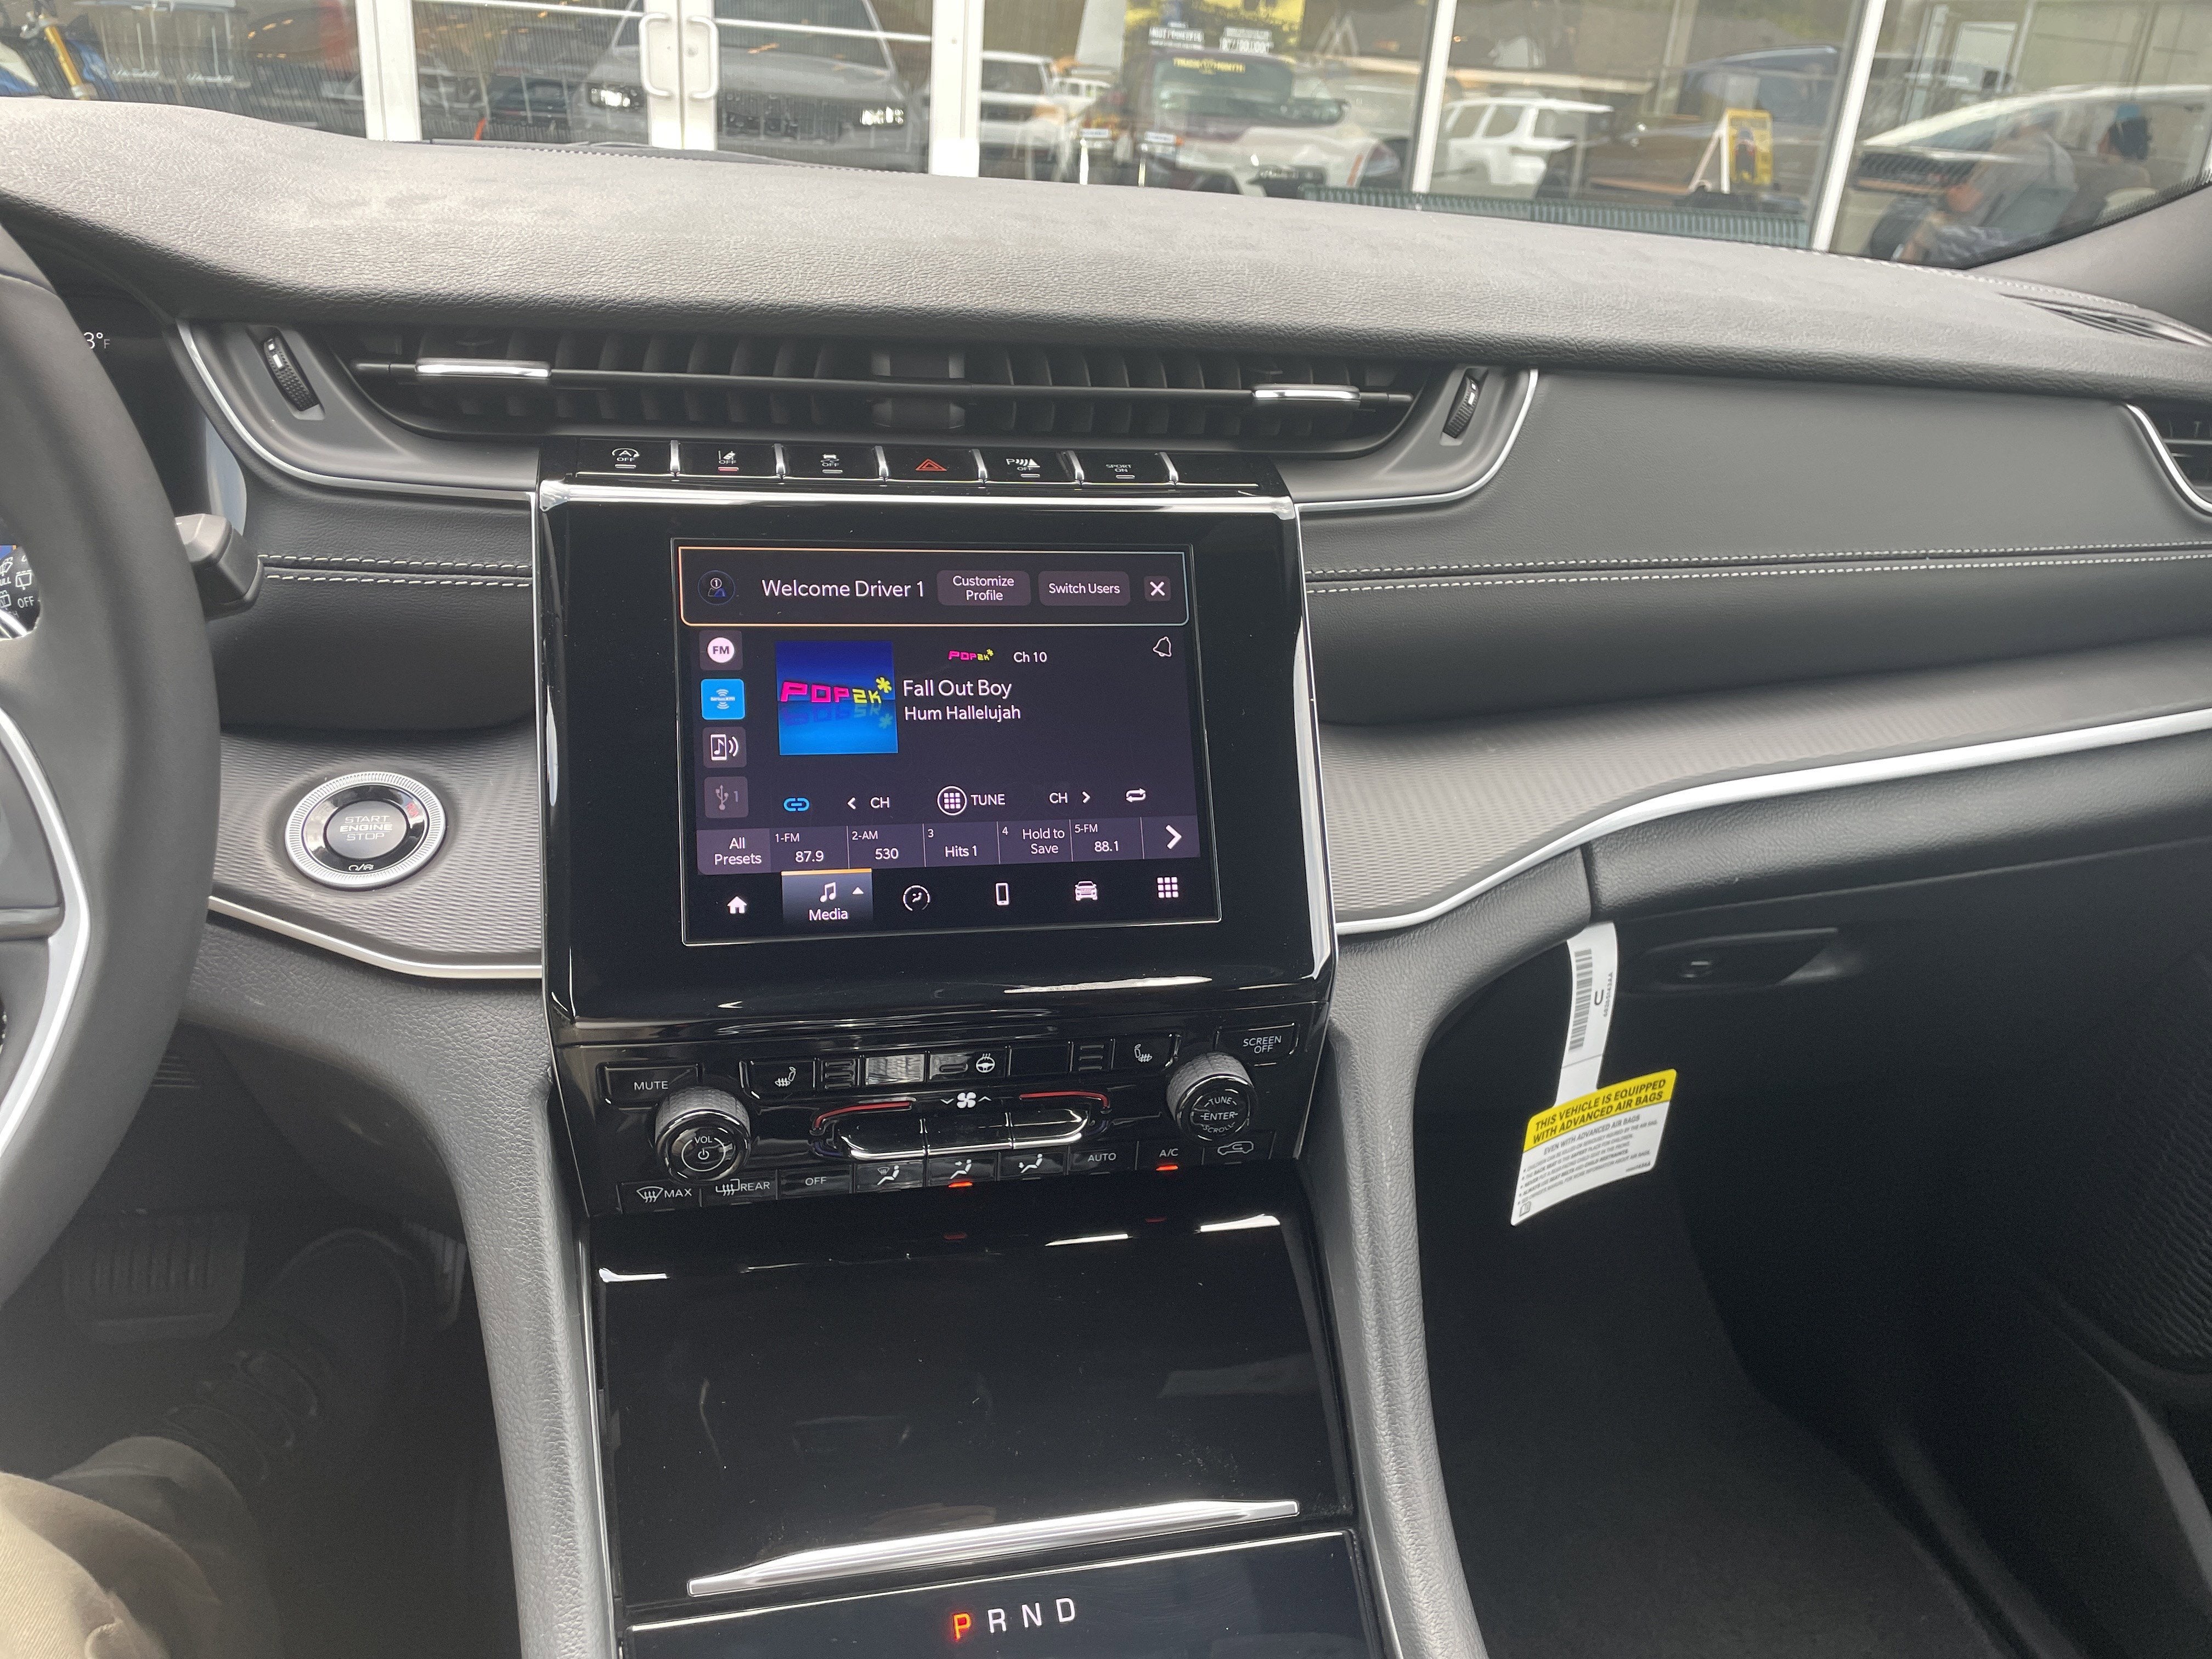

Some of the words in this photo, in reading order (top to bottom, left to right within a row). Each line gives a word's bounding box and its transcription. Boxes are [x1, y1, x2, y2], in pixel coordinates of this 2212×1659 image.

[953, 575, 1014, 586] Customize
[762, 579, 850, 596] Welcome
[855, 580, 911, 597] Driver
[916, 581, 924, 597] 1
[1048, 583, 1086, 594] Switch
[1088, 584, 1120, 594] Users
[966, 590, 1003, 601] Profile
[18, 596, 34, 608] OFF
[713, 646, 730, 654] FM
[1014, 652, 1030, 663] Ch
[1034, 652, 1047, 663] 10
[903, 680, 934, 697] Fall
[938, 680, 974, 696] Out
[978, 679, 1012, 699] Boy
[905, 707, 942, 721] Hum
[946, 704, 1021, 722] Hallelujah
[870, 797, 889, 809] CH
[970, 794, 1006, 805] TUNE
[1049, 792, 1068, 804] CH
[340, 824, 393, 832] ENGINE
[928, 829, 934, 838] 3
[1002, 827, 1008, 836] 4
[1023, 828, 1051, 839] Hold
[1053, 828, 1065, 839] to
[1075, 824, 1098, 833] 5-FM
[346, 832, 385, 841] STOP
[775, 833, 800, 843] 1-FM
[852, 831, 878, 840] 2-AM
[729, 837, 745, 849] All
[1094, 841, 1119, 852] 88.1
[875, 848, 899, 860] 530
[945, 846, 969, 857] Hits
[972, 845, 978, 856] 1
[1031, 844, 1058, 855] Save
[714, 853, 762, 865] Presets
[795, 850, 823, 862] 87.9
[809, 908, 848, 921] Media
[1243, 1036, 1282, 1047] SCREEN
[1254, 1044, 1274, 1054] OFF
[634, 1080, 669, 1091] MUTE
[1209, 1096, 1233, 1106] TUNE
[1536, 1114, 1556, 1131] THIS
[1559, 1097, 1601, 1121] VEHICLE
[1601, 1094, 1612, 1105] IS
[1614, 1079, 1666, 1101] EQUIPPED
[1204, 1111, 1235, 1121] ENTER
[1533, 1125, 1558, 1144] WITH
[1558, 1105, 1613, 1133] ADVANCED
[1615, 1099, 1633, 1111] AIR
[1635, 1091, 1663, 1105] BAGS
[1202, 1124, 1232, 1133] SCROLL
[1577, 1124, 1611, 1141] ADVANCED
[1611, 1120, 1622, 1128] AIR
[695, 1135, 713, 1144] VOL
[1087, 1153, 1116, 1163] AUTO
[1159, 1149, 1179, 1158] A/C
[740, 1182, 771, 1192] REAR
[805, 1177, 827, 1187] OFF
[664, 1188, 692, 1198] MAX
[953, 1613, 972, 1639] P
[988, 1608, 1007, 1633] R
[1022, 1602, 1042, 1628] N
[1056, 1598, 1075, 1622] D
